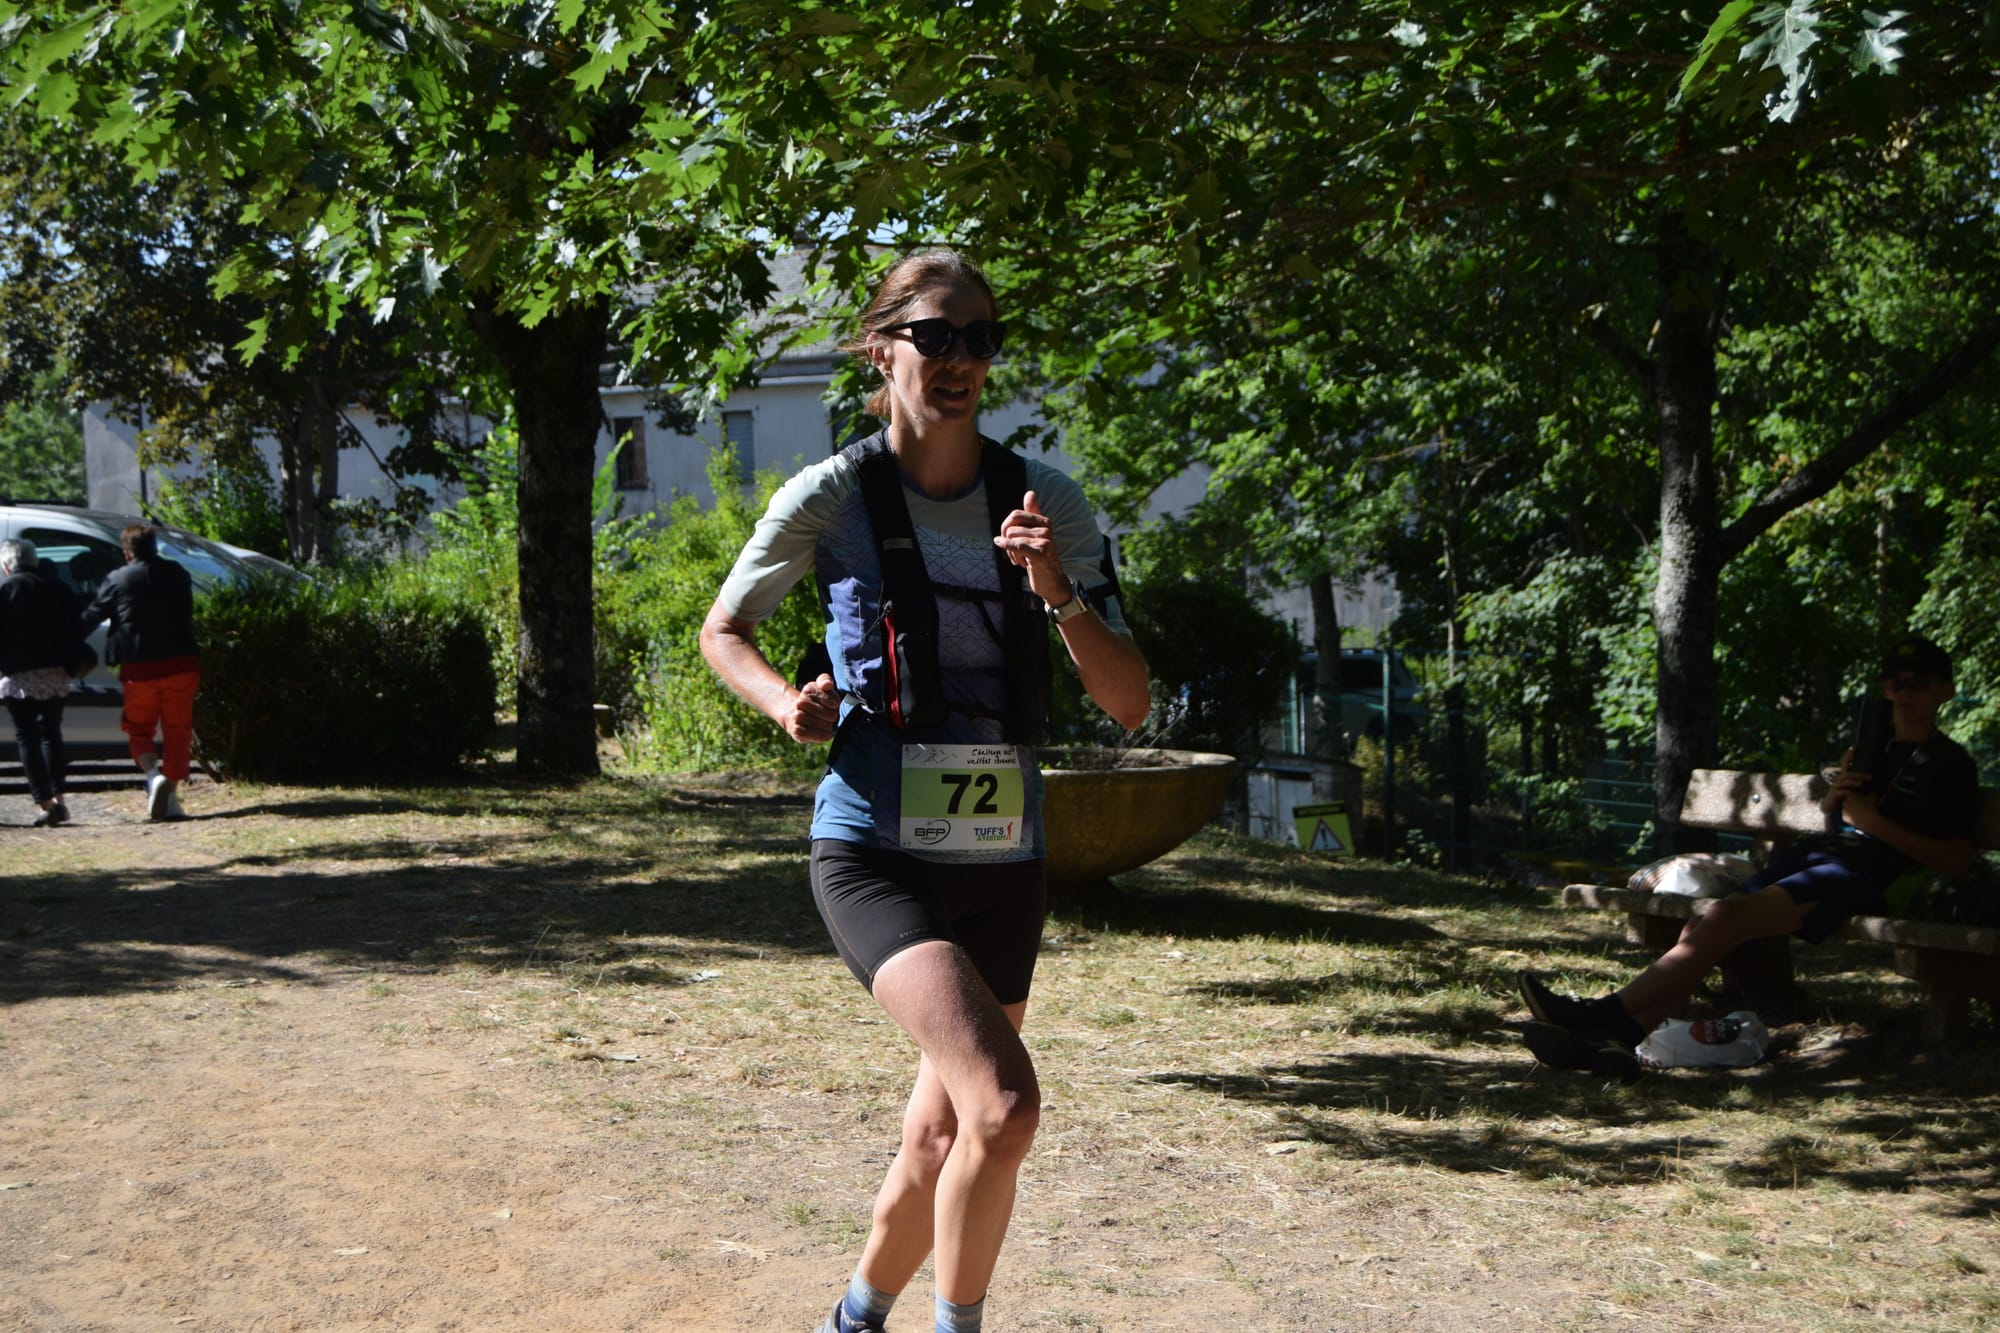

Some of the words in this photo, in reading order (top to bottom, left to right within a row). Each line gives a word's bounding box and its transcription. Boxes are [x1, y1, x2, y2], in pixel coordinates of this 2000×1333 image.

[941, 773, 998, 815] 72
[914, 827, 946, 837] BFP
[973, 826, 1004, 836] TUFF'S
